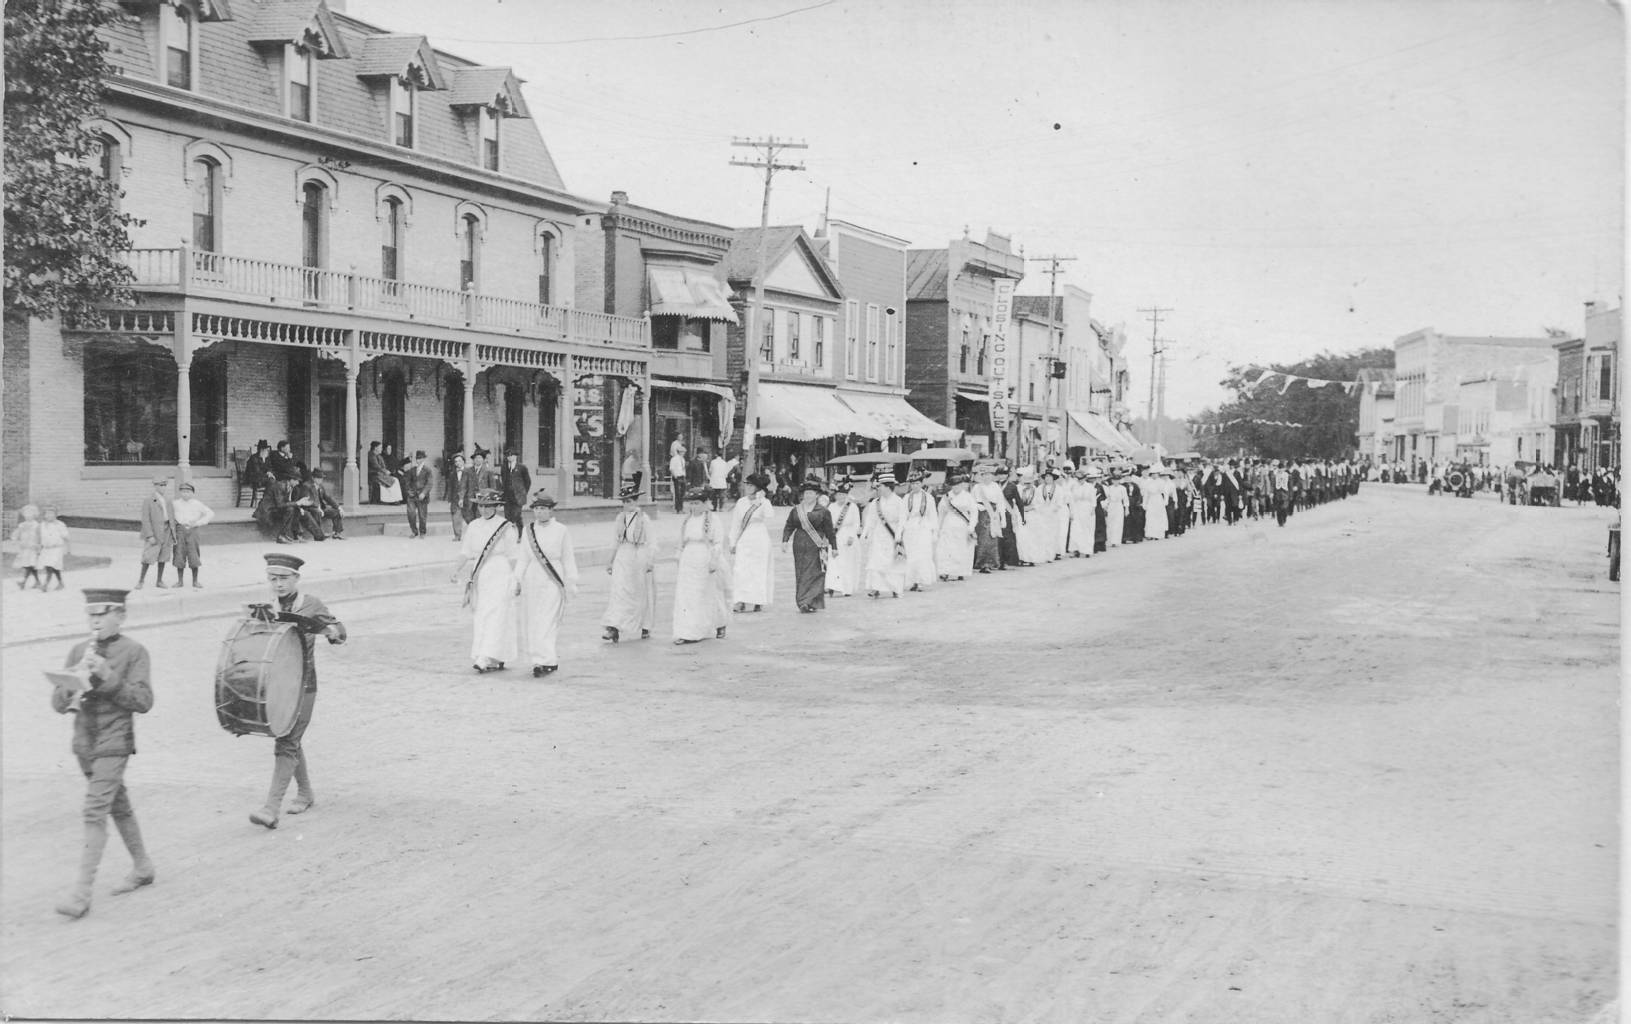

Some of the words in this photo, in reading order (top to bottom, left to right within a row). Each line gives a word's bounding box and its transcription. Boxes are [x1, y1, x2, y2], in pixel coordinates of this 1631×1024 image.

[994, 285, 1011, 352] CLOSING
[993, 357, 1006, 386] OUT
[992, 390, 1005, 429] SALE
